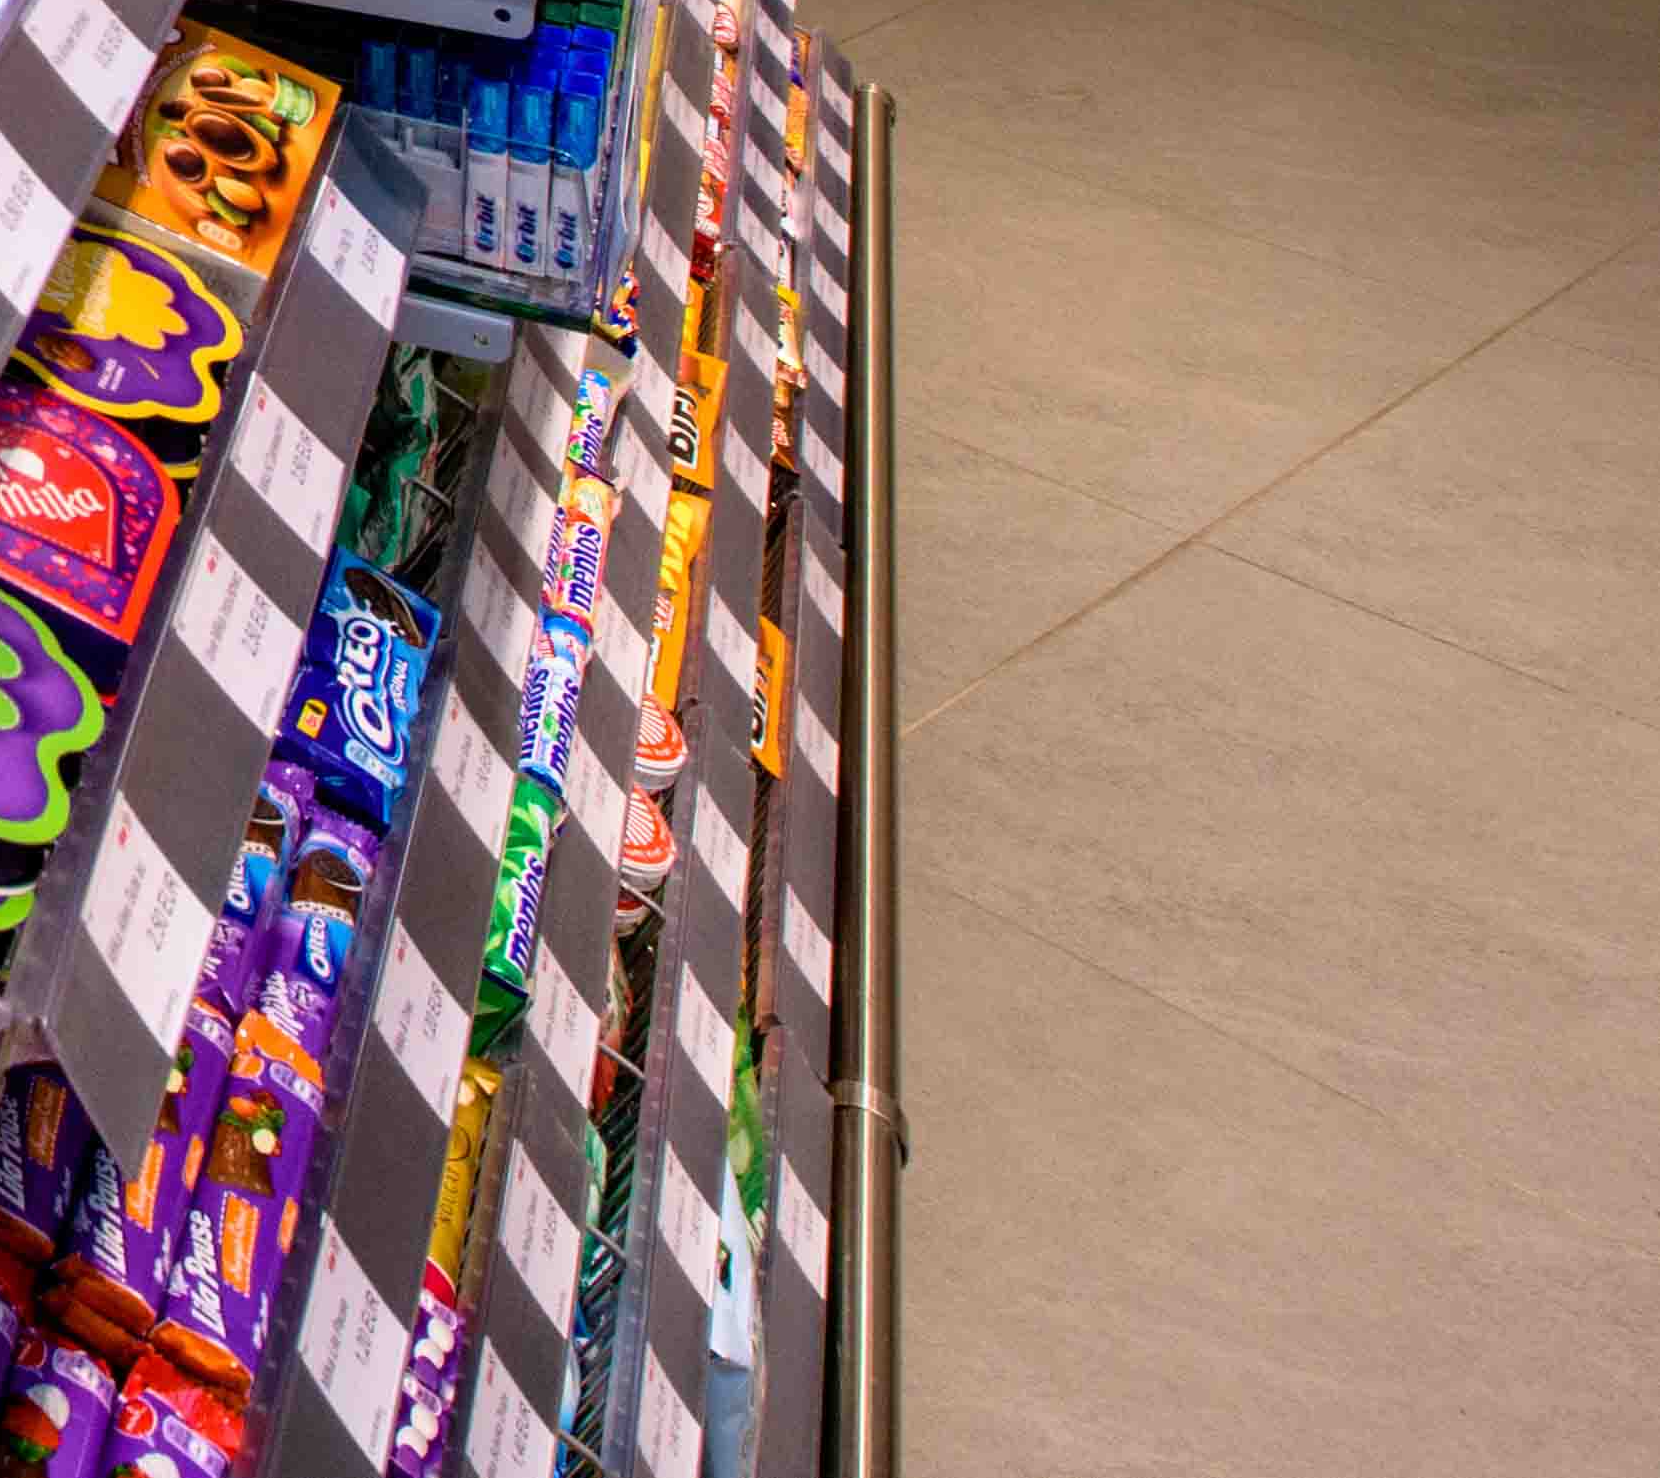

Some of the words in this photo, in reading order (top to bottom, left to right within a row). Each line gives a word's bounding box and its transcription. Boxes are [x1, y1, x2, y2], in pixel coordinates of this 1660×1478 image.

[565, 520, 606, 618] mentos
[336, 617, 394, 750] OREO
[507, 851, 547, 973] mentos
